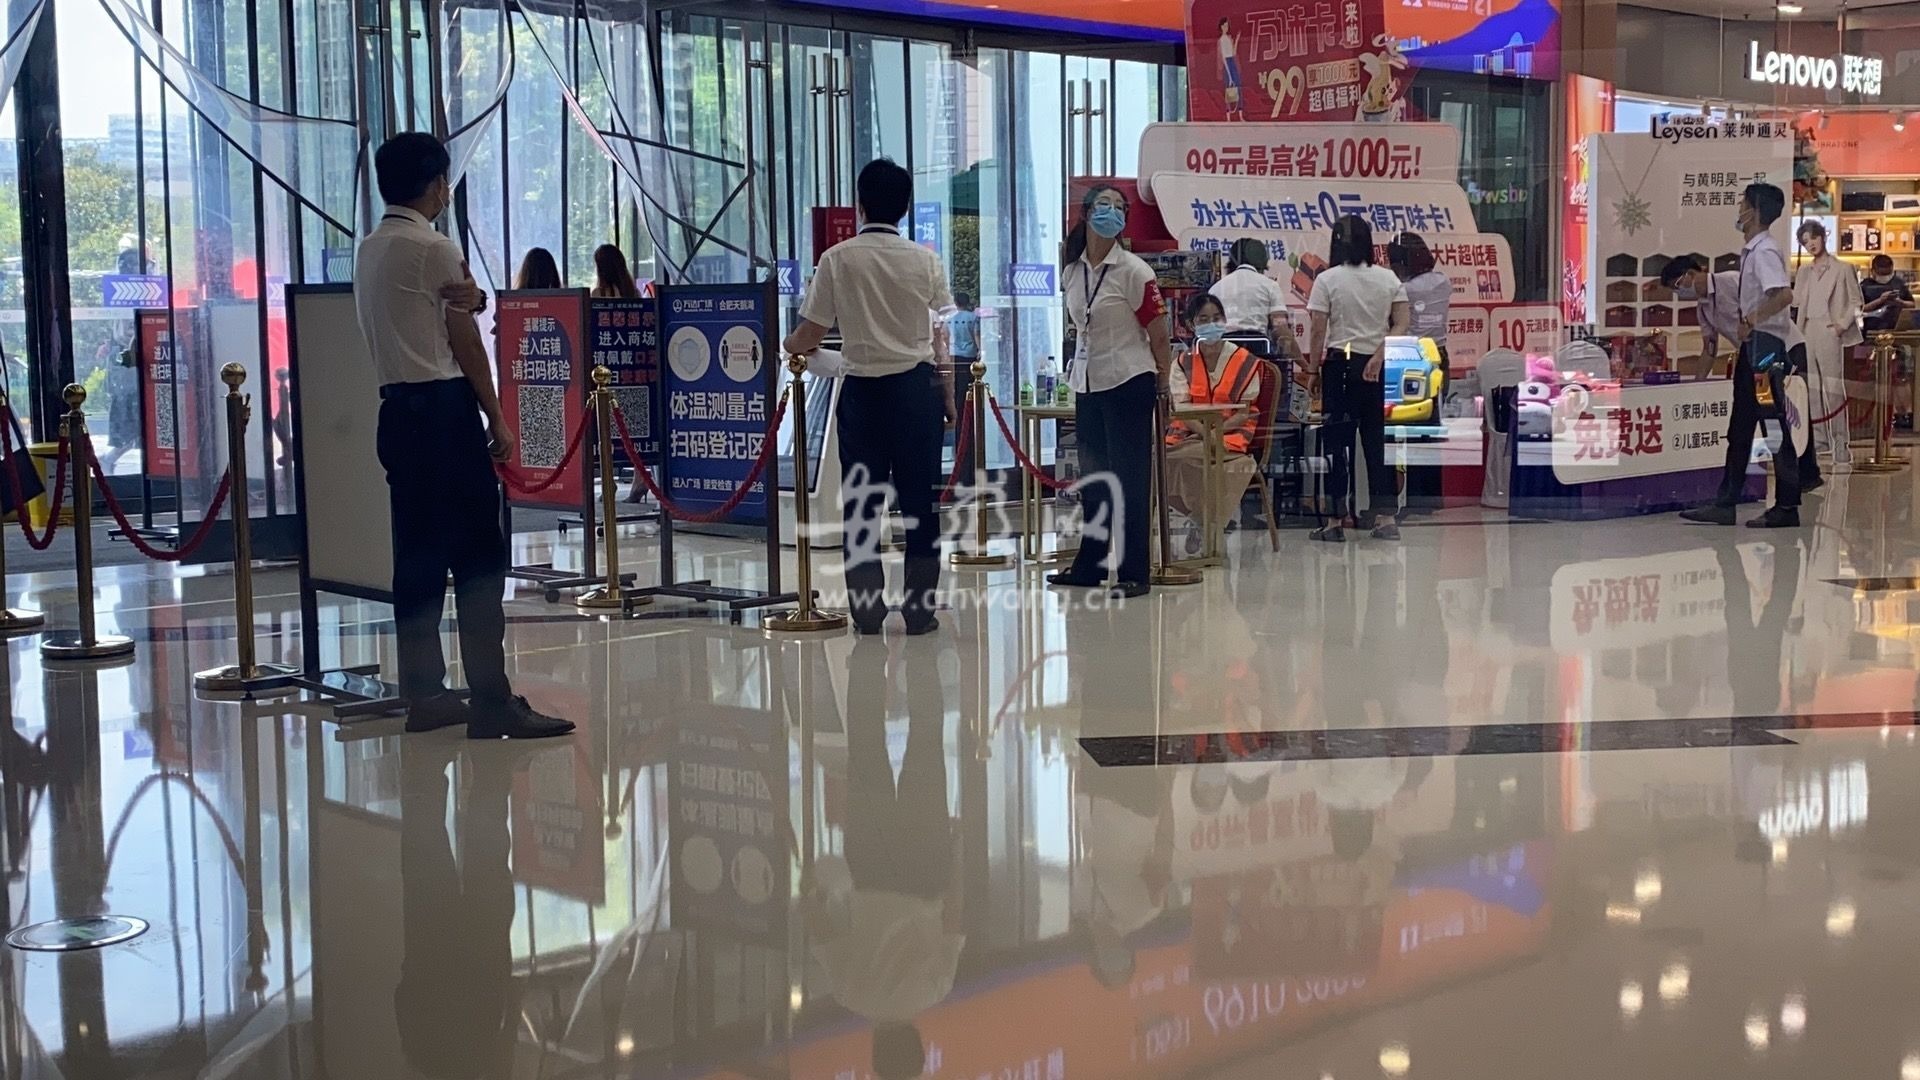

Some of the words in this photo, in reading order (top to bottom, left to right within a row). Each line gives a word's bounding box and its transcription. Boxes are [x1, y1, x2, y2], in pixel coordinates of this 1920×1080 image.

[1345, 3, 1359, 45] 来啦
[1751, 41, 1837, 90] Lenovo
[1843, 55, 1882, 95] 联想
[1309, 83, 1362, 112] 超值福利
[1652, 117, 1717, 144] Leysen
[1722, 122, 1788, 138] 莱绅通灵
[1187, 138, 1421, 179] 99元最高省1000元!
[1191, 191, 1454, 232] 办光大信用卡0元得万味卡!
[519, 337, 562, 356] 进入店铺
[599, 331, 656, 346] 进入商场
[512, 360, 571, 381] 请扫码核验
[670, 391, 765, 421] 体温测量点
[671, 430, 766, 460] 扫码登记区
[1574, 405, 1663, 461] 免费送
